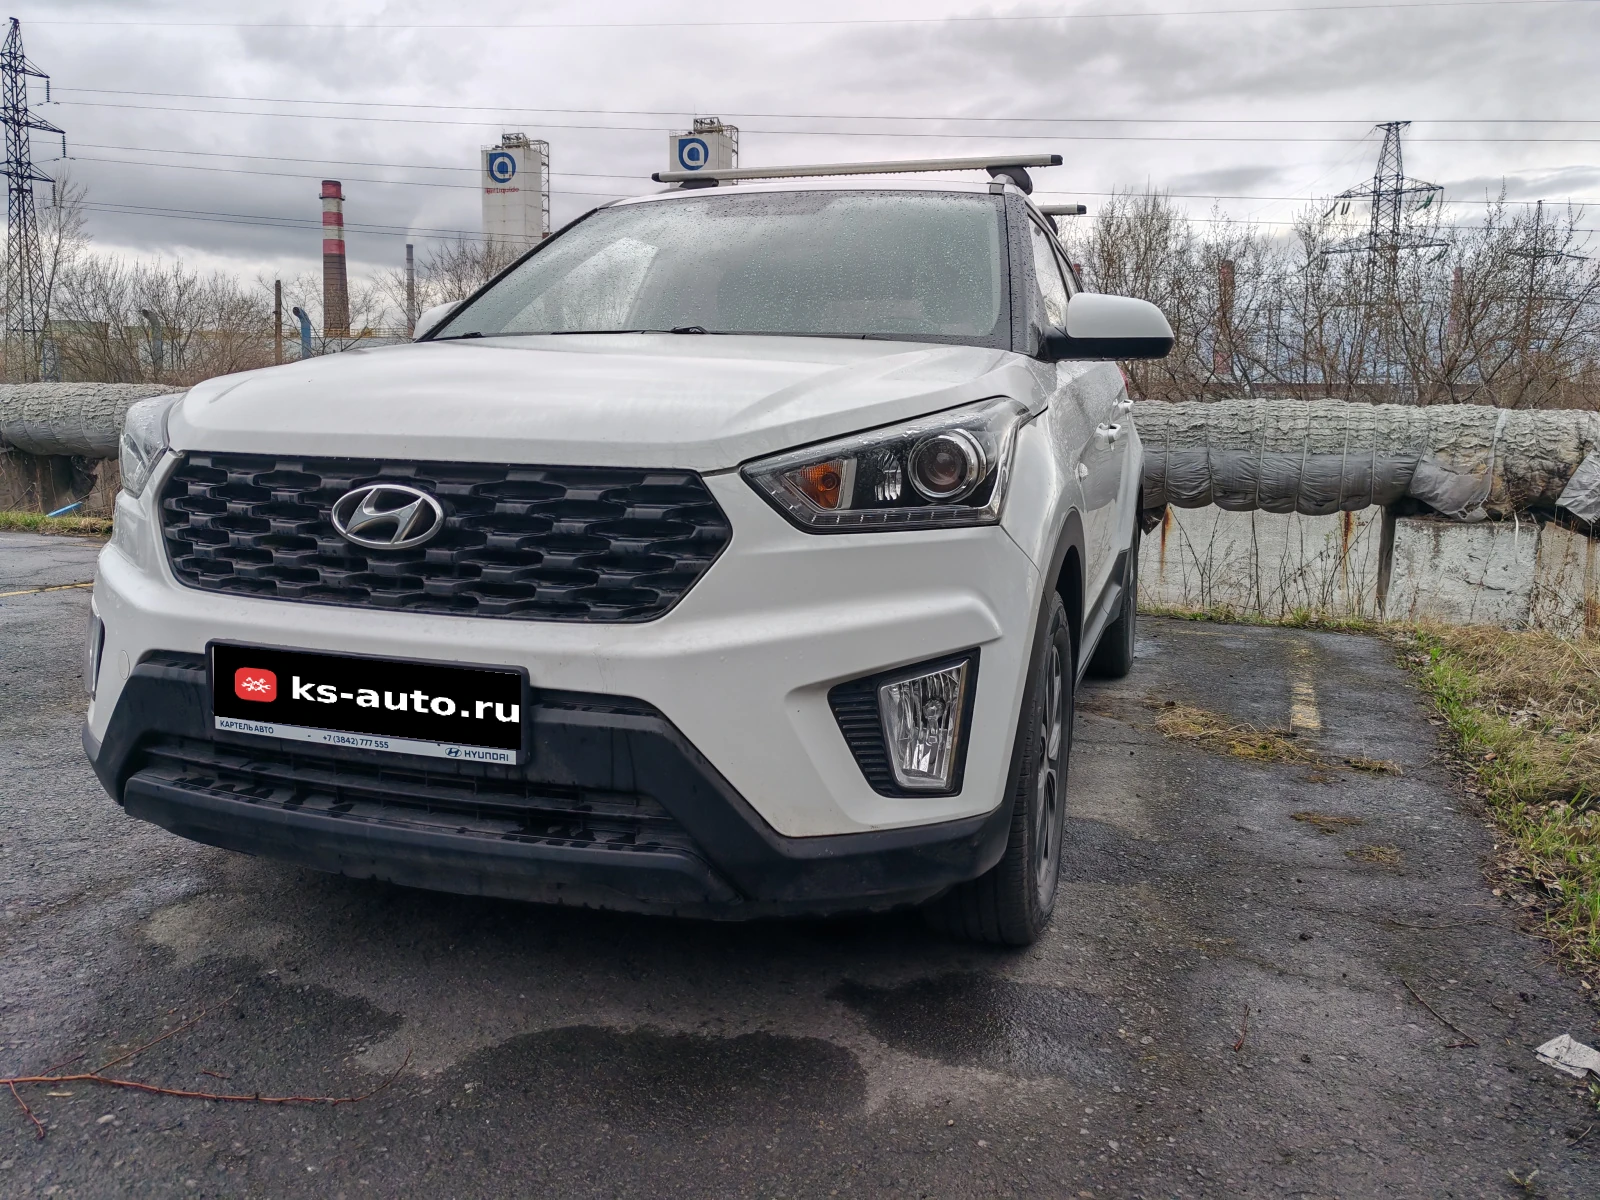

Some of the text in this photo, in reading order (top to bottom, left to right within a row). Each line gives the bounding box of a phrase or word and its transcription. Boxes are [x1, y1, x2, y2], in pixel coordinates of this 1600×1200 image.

[219, 720, 274, 735] КАРТЕЛЬ АВТО
[322, 734, 389, 749] +7 (3842) 777 555
[464, 749, 509, 762] HYUNDAI
